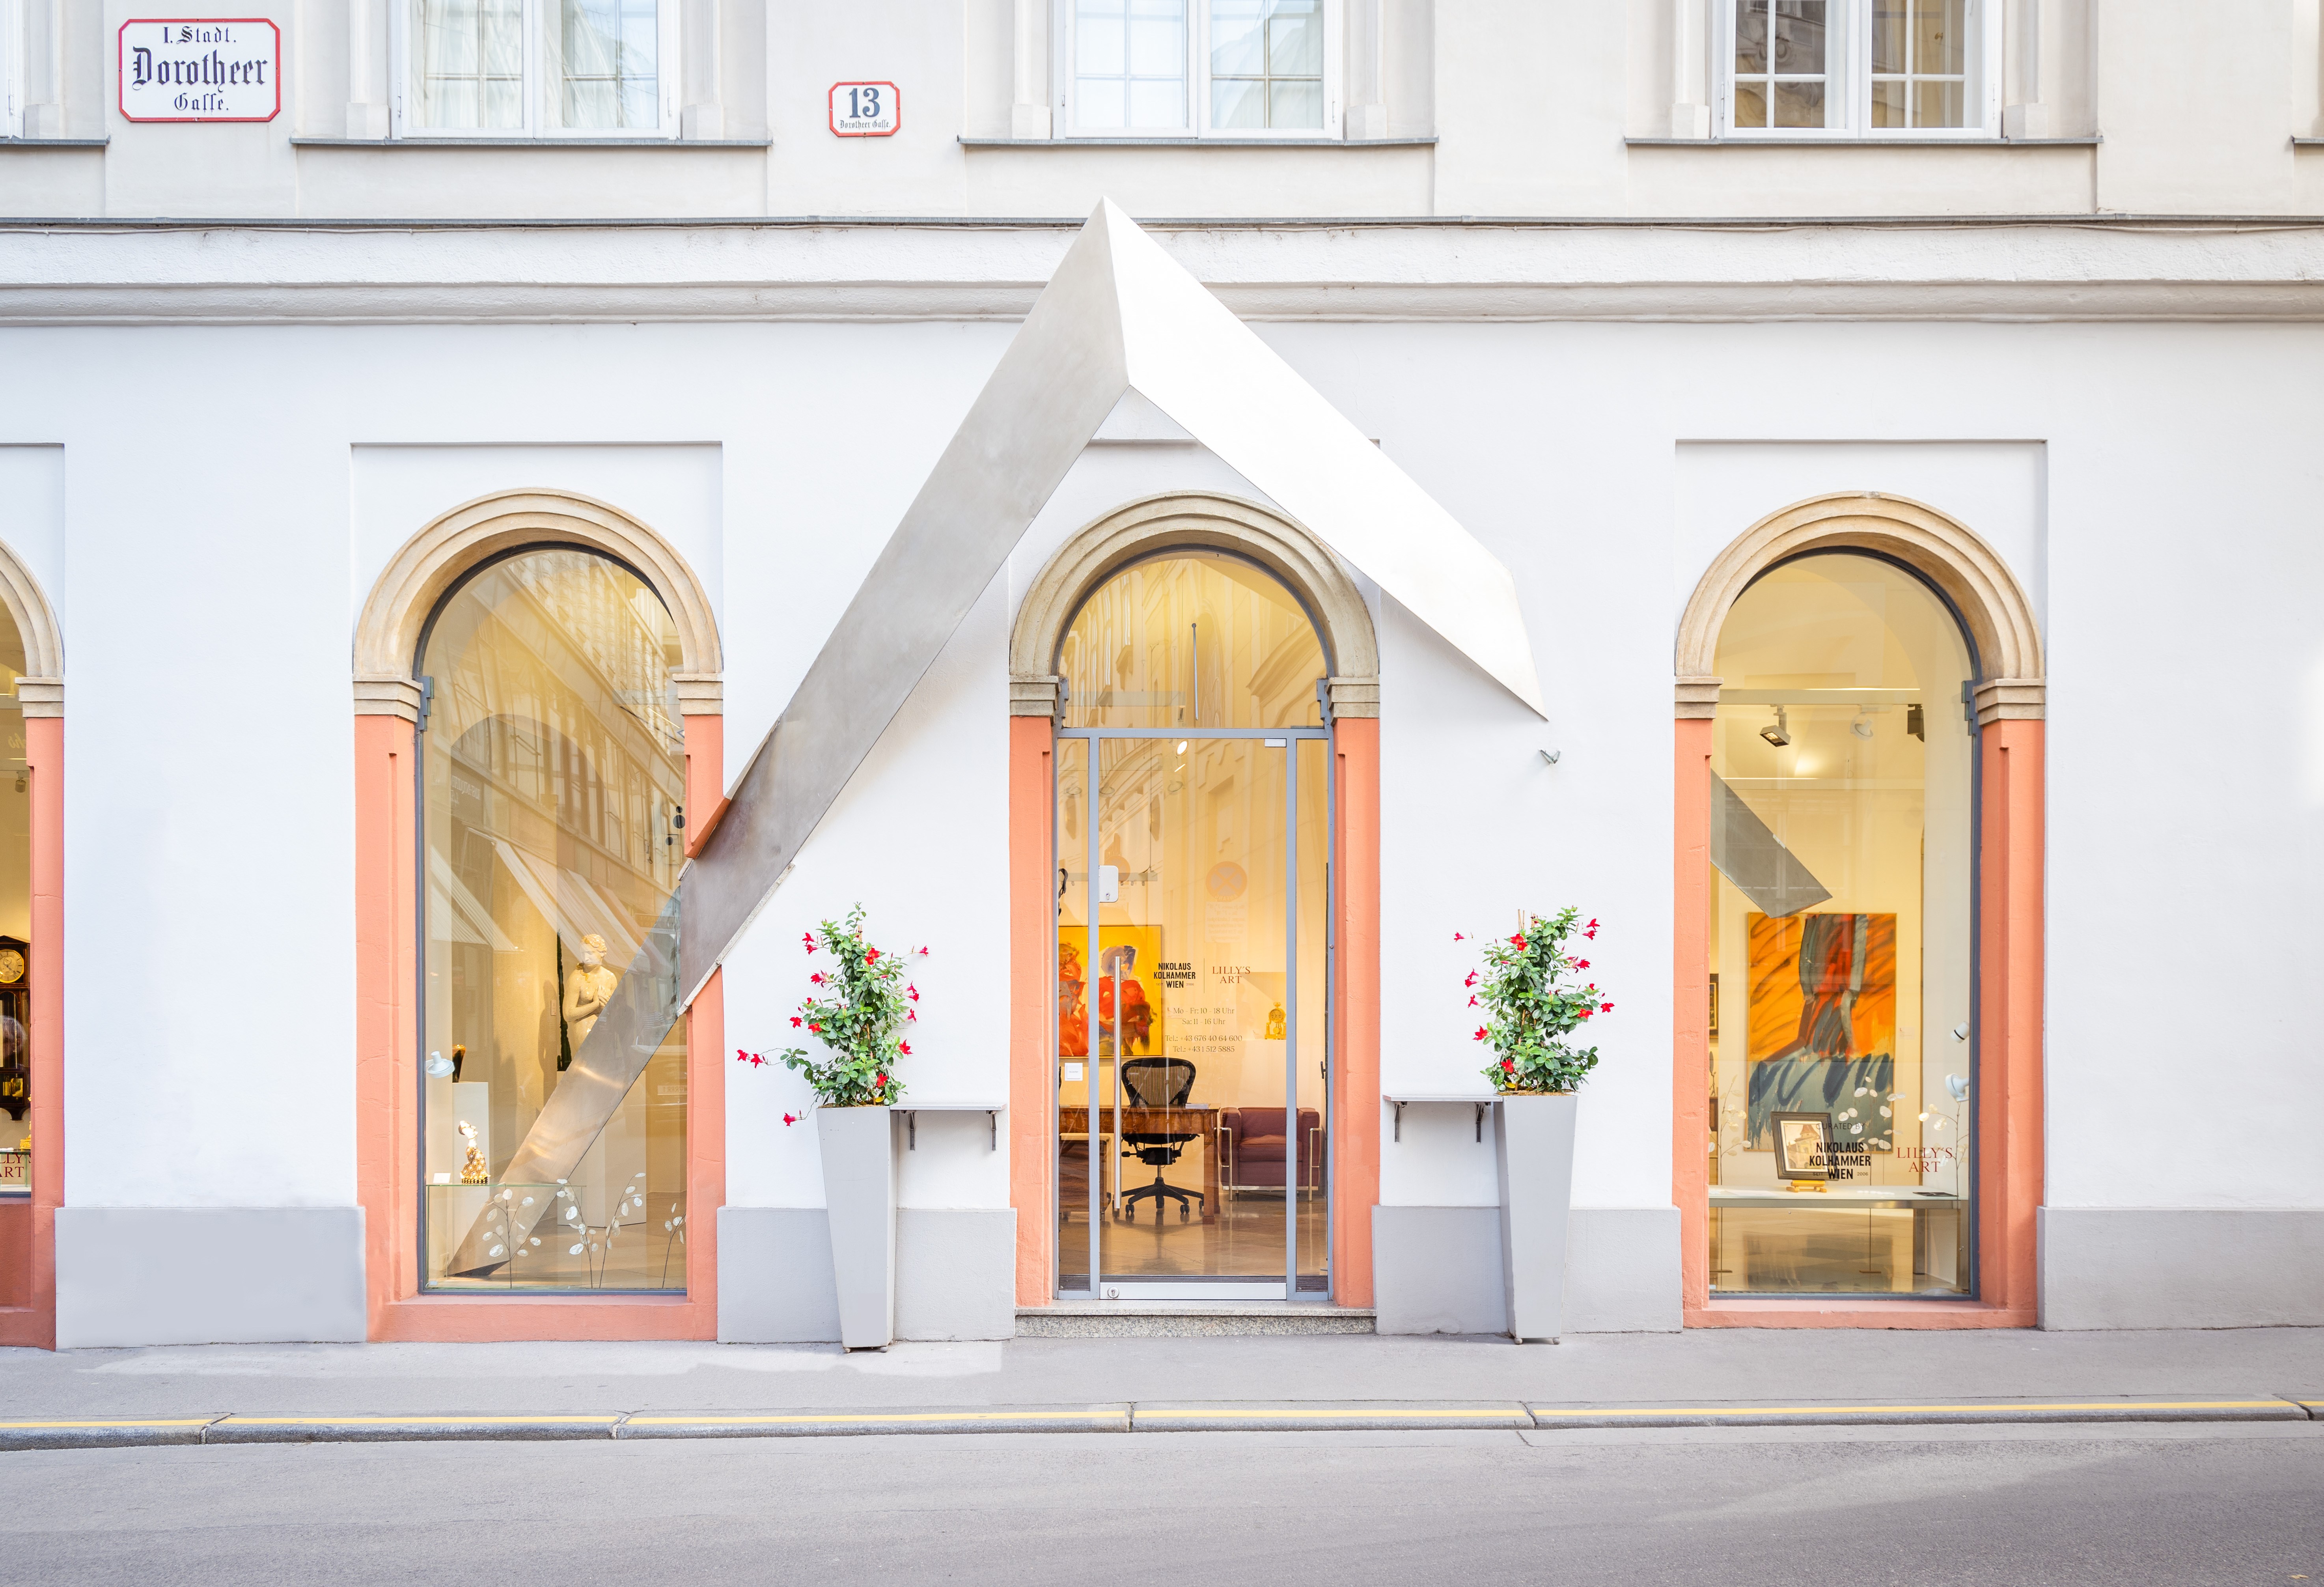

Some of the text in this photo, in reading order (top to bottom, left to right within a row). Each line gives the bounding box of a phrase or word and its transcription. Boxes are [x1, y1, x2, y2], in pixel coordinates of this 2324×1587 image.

[176, 26, 236, 44] Stadt.
[132, 46, 268, 92] Dorotheer
[849, 88, 880, 118] 13
[840, 119, 871, 129] Dorotheer
[1816, 1142, 1864, 1153] NIKOLAUS
[1897, 1147, 1953, 1158] LILLY'S
[1809, 1156, 1871, 1166] KOLHAMMER
[1909, 1161, 1940, 1172] ART
[1828, 1169, 1853, 1179] WIEN
